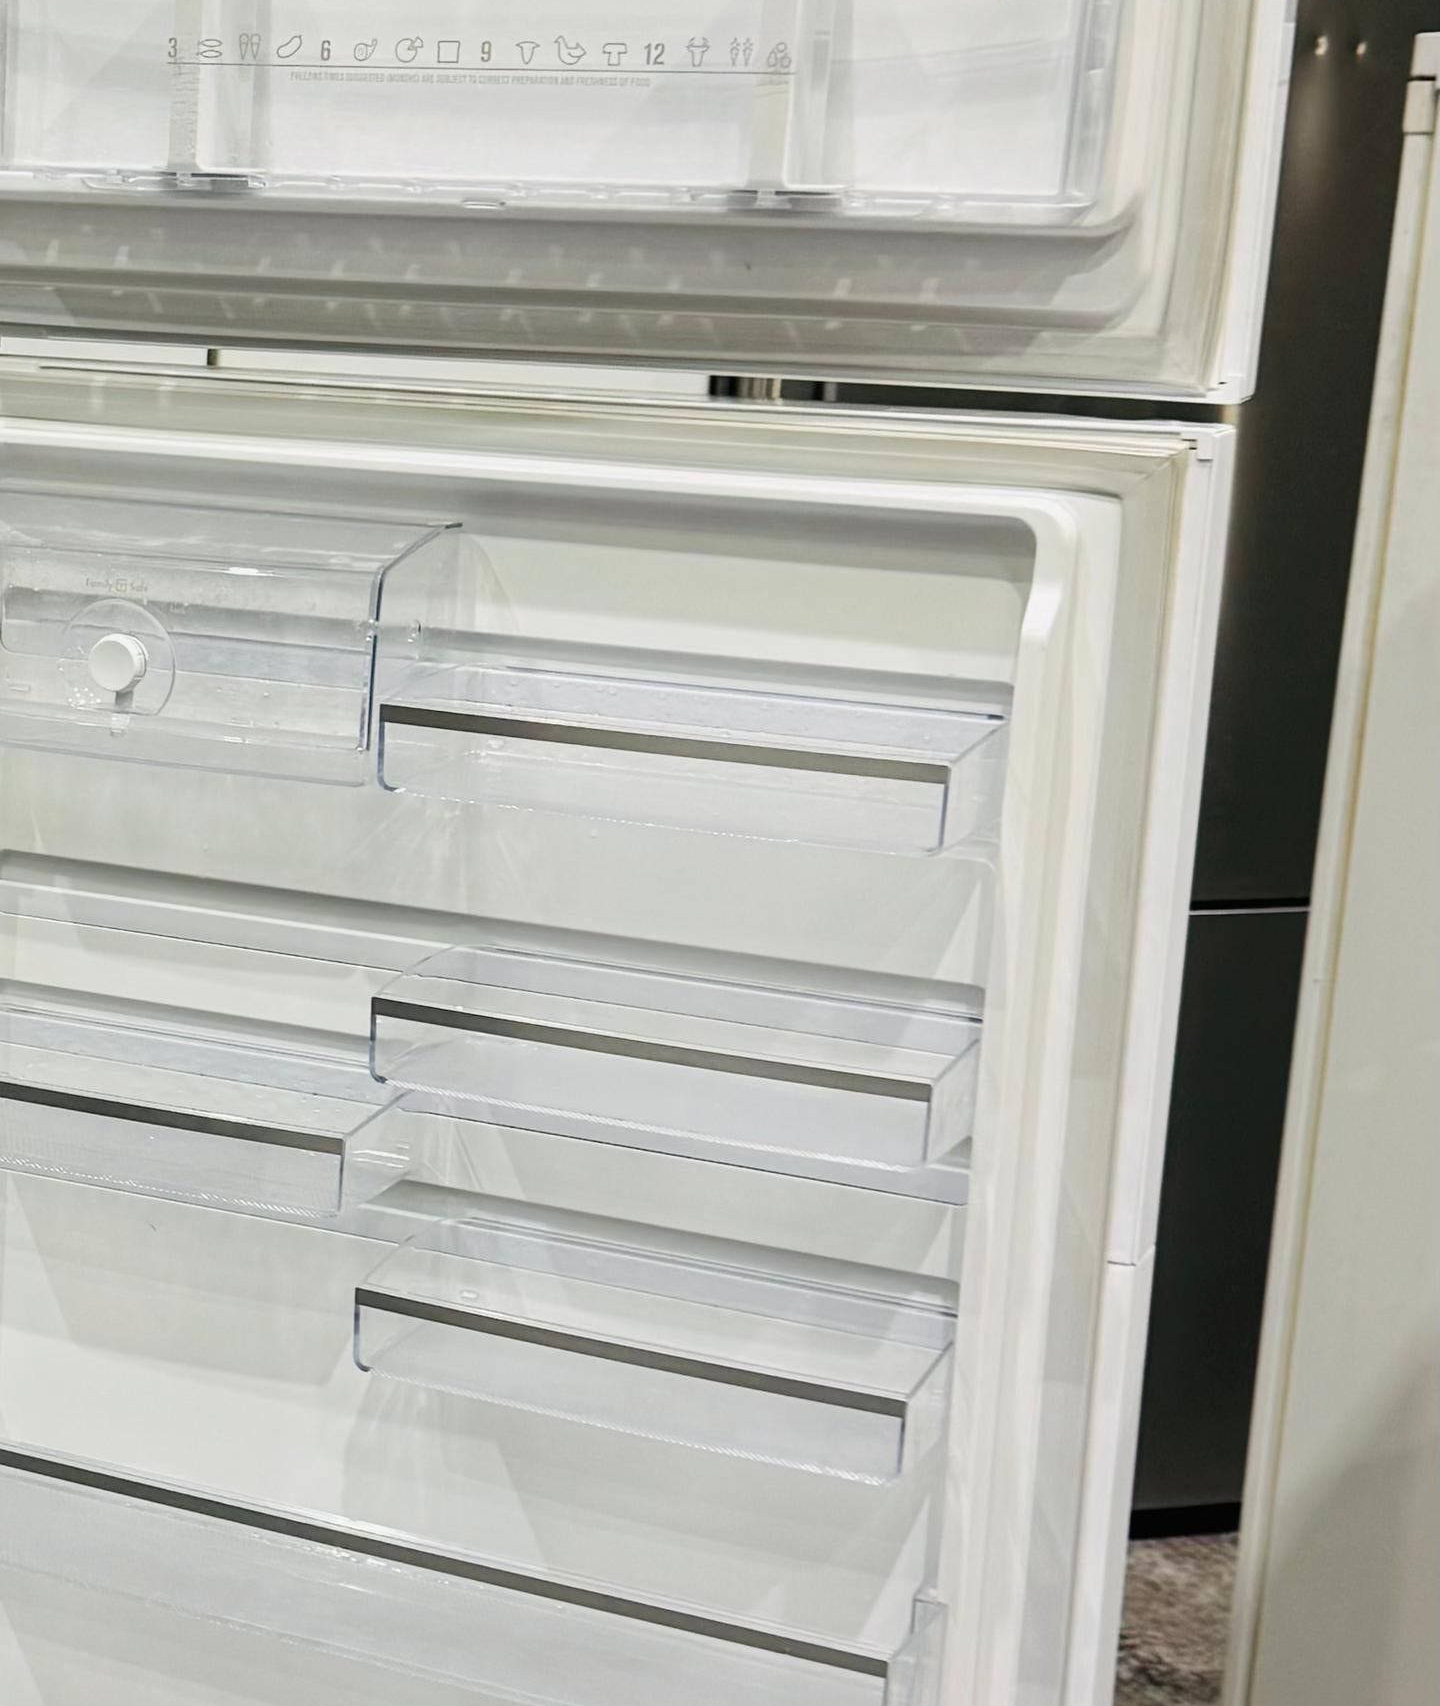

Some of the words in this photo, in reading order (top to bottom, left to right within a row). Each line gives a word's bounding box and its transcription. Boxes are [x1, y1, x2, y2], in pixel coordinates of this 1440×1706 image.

[167, 37, 178, 59] 3
[320, 39, 331, 61] 6
[480, 40, 492, 62] 9
[643, 43, 665, 66] 12
